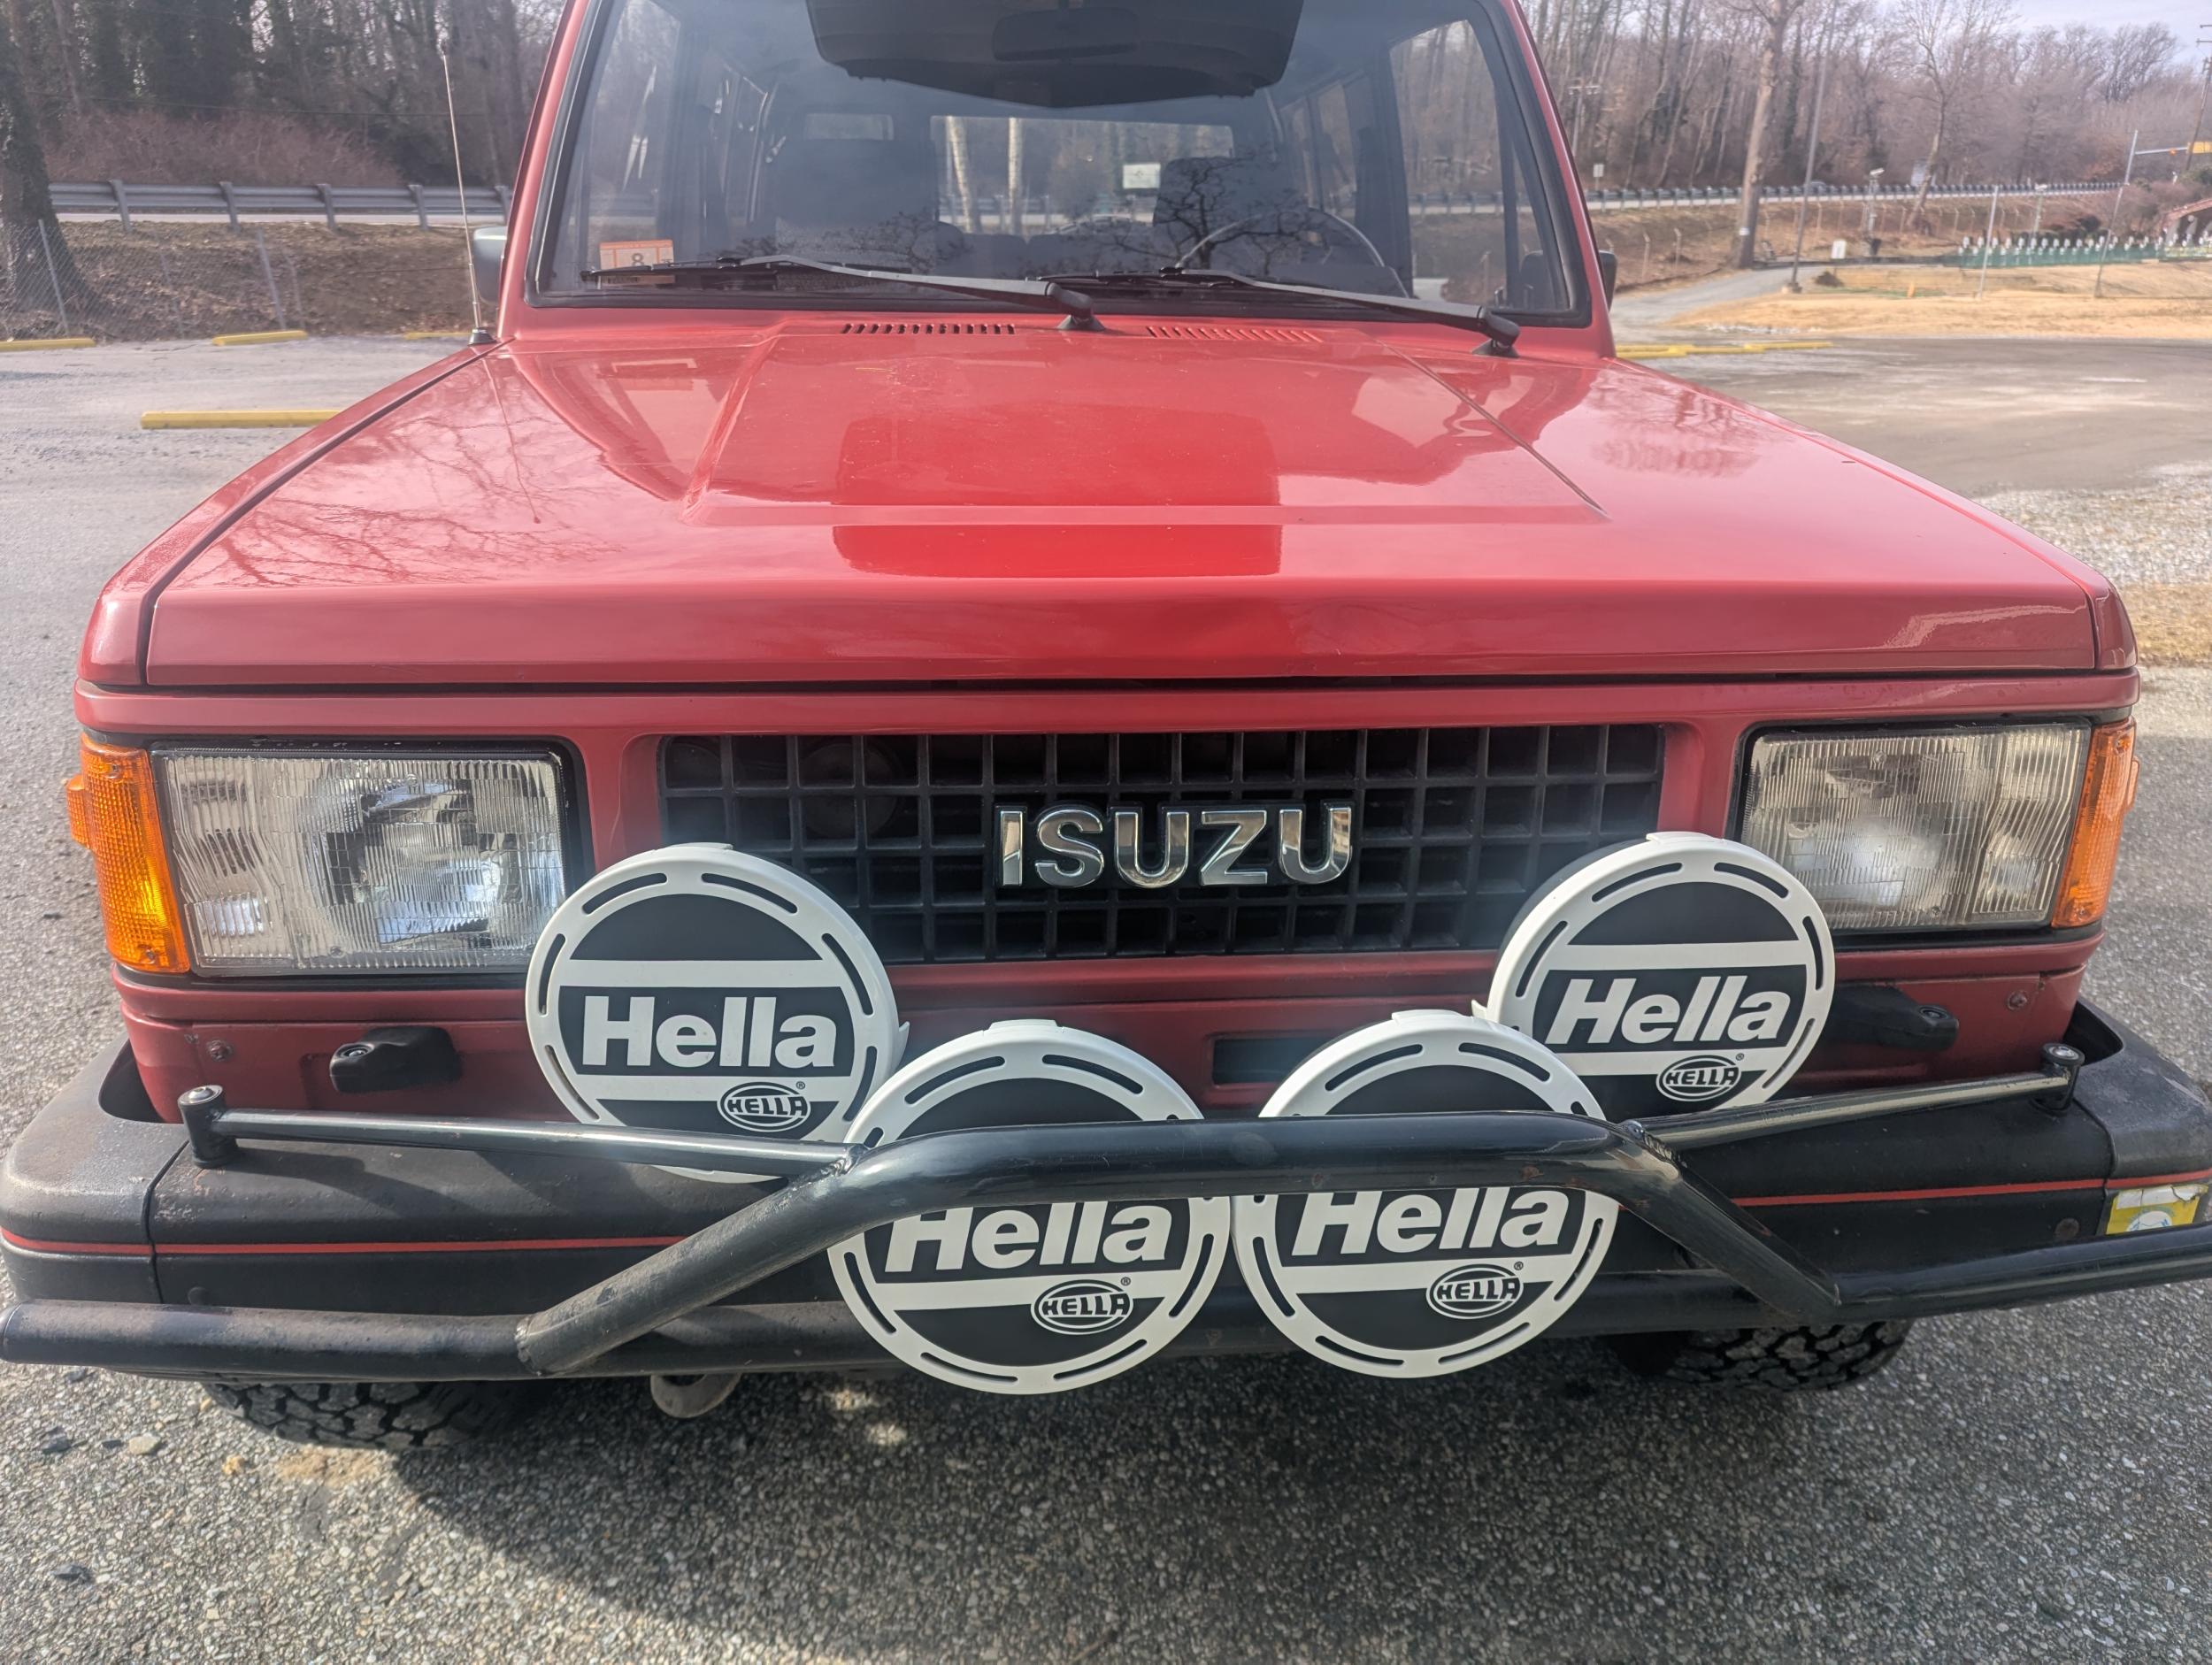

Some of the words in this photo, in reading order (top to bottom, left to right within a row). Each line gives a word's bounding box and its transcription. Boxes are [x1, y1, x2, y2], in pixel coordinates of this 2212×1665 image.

[999, 806, 1353, 888] ISUZU
[582, 995, 837, 1069] Hella
[1544, 975, 1790, 1044] Hella
[728, 1097, 809, 1117] HELLA
[1665, 1068, 1740, 1086] HELLA
[885, 1201, 1172, 1273] Hella
[1291, 1187, 1570, 1256] Hella
[1042, 1293, 1130, 1316] HELLA
[1436, 1278, 1521, 1301] HELLA
